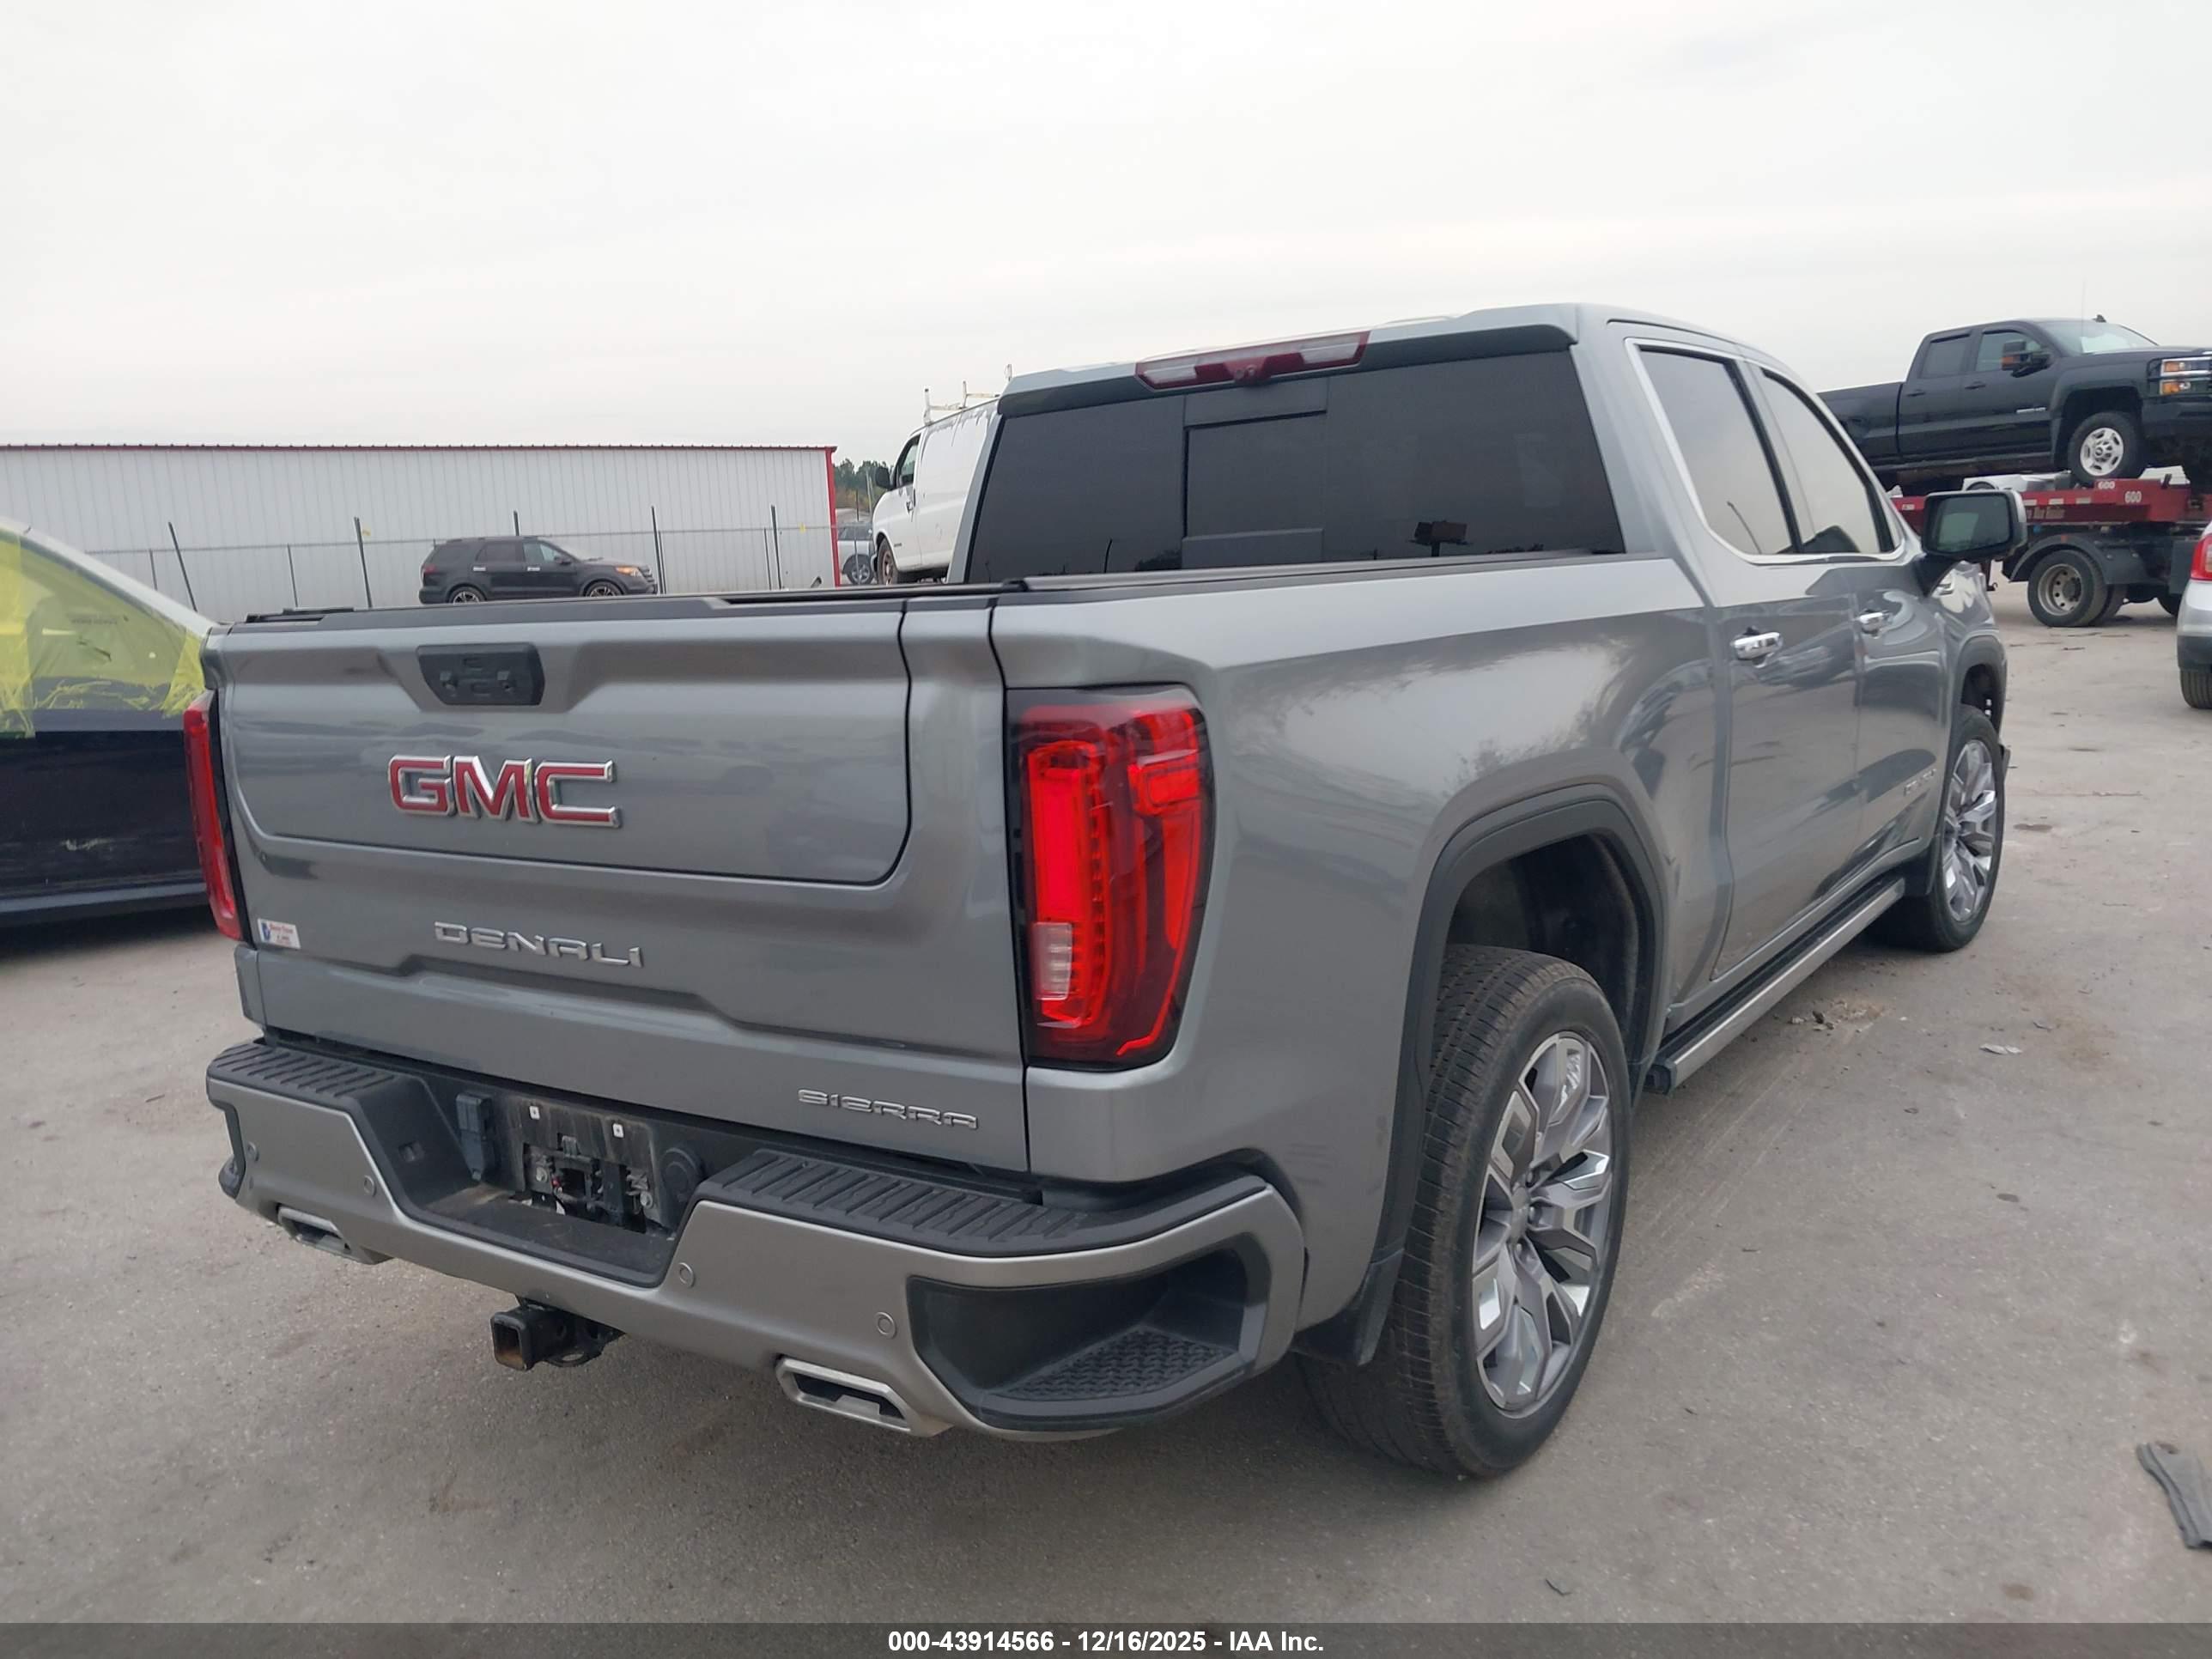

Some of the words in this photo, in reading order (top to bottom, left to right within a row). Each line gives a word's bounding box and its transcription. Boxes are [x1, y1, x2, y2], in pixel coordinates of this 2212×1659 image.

[2098, 480, 2116, 489] 600
[2124, 490, 2142, 503] 600
[388, 755, 620, 828] GMC
[434, 921, 642, 968] DENALI
[798, 1088, 978, 1129] SIERRA
